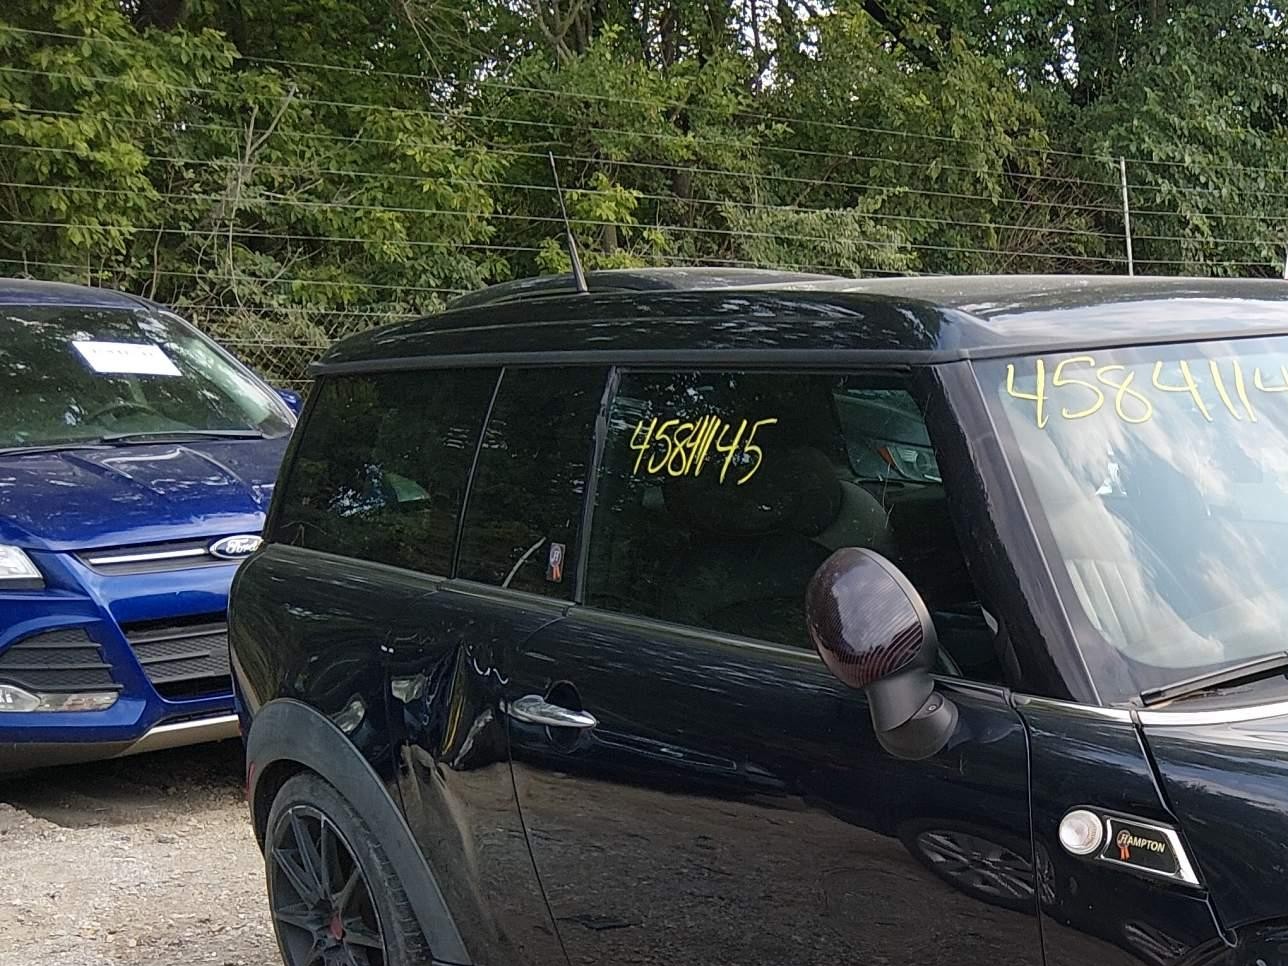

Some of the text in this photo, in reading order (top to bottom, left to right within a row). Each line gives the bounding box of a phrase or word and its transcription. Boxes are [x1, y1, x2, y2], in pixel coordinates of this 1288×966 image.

[629, 414, 778, 486] 45841145
[225, 538, 259, 555] Ford
[1117, 832, 1166, 854] HAMPTON
